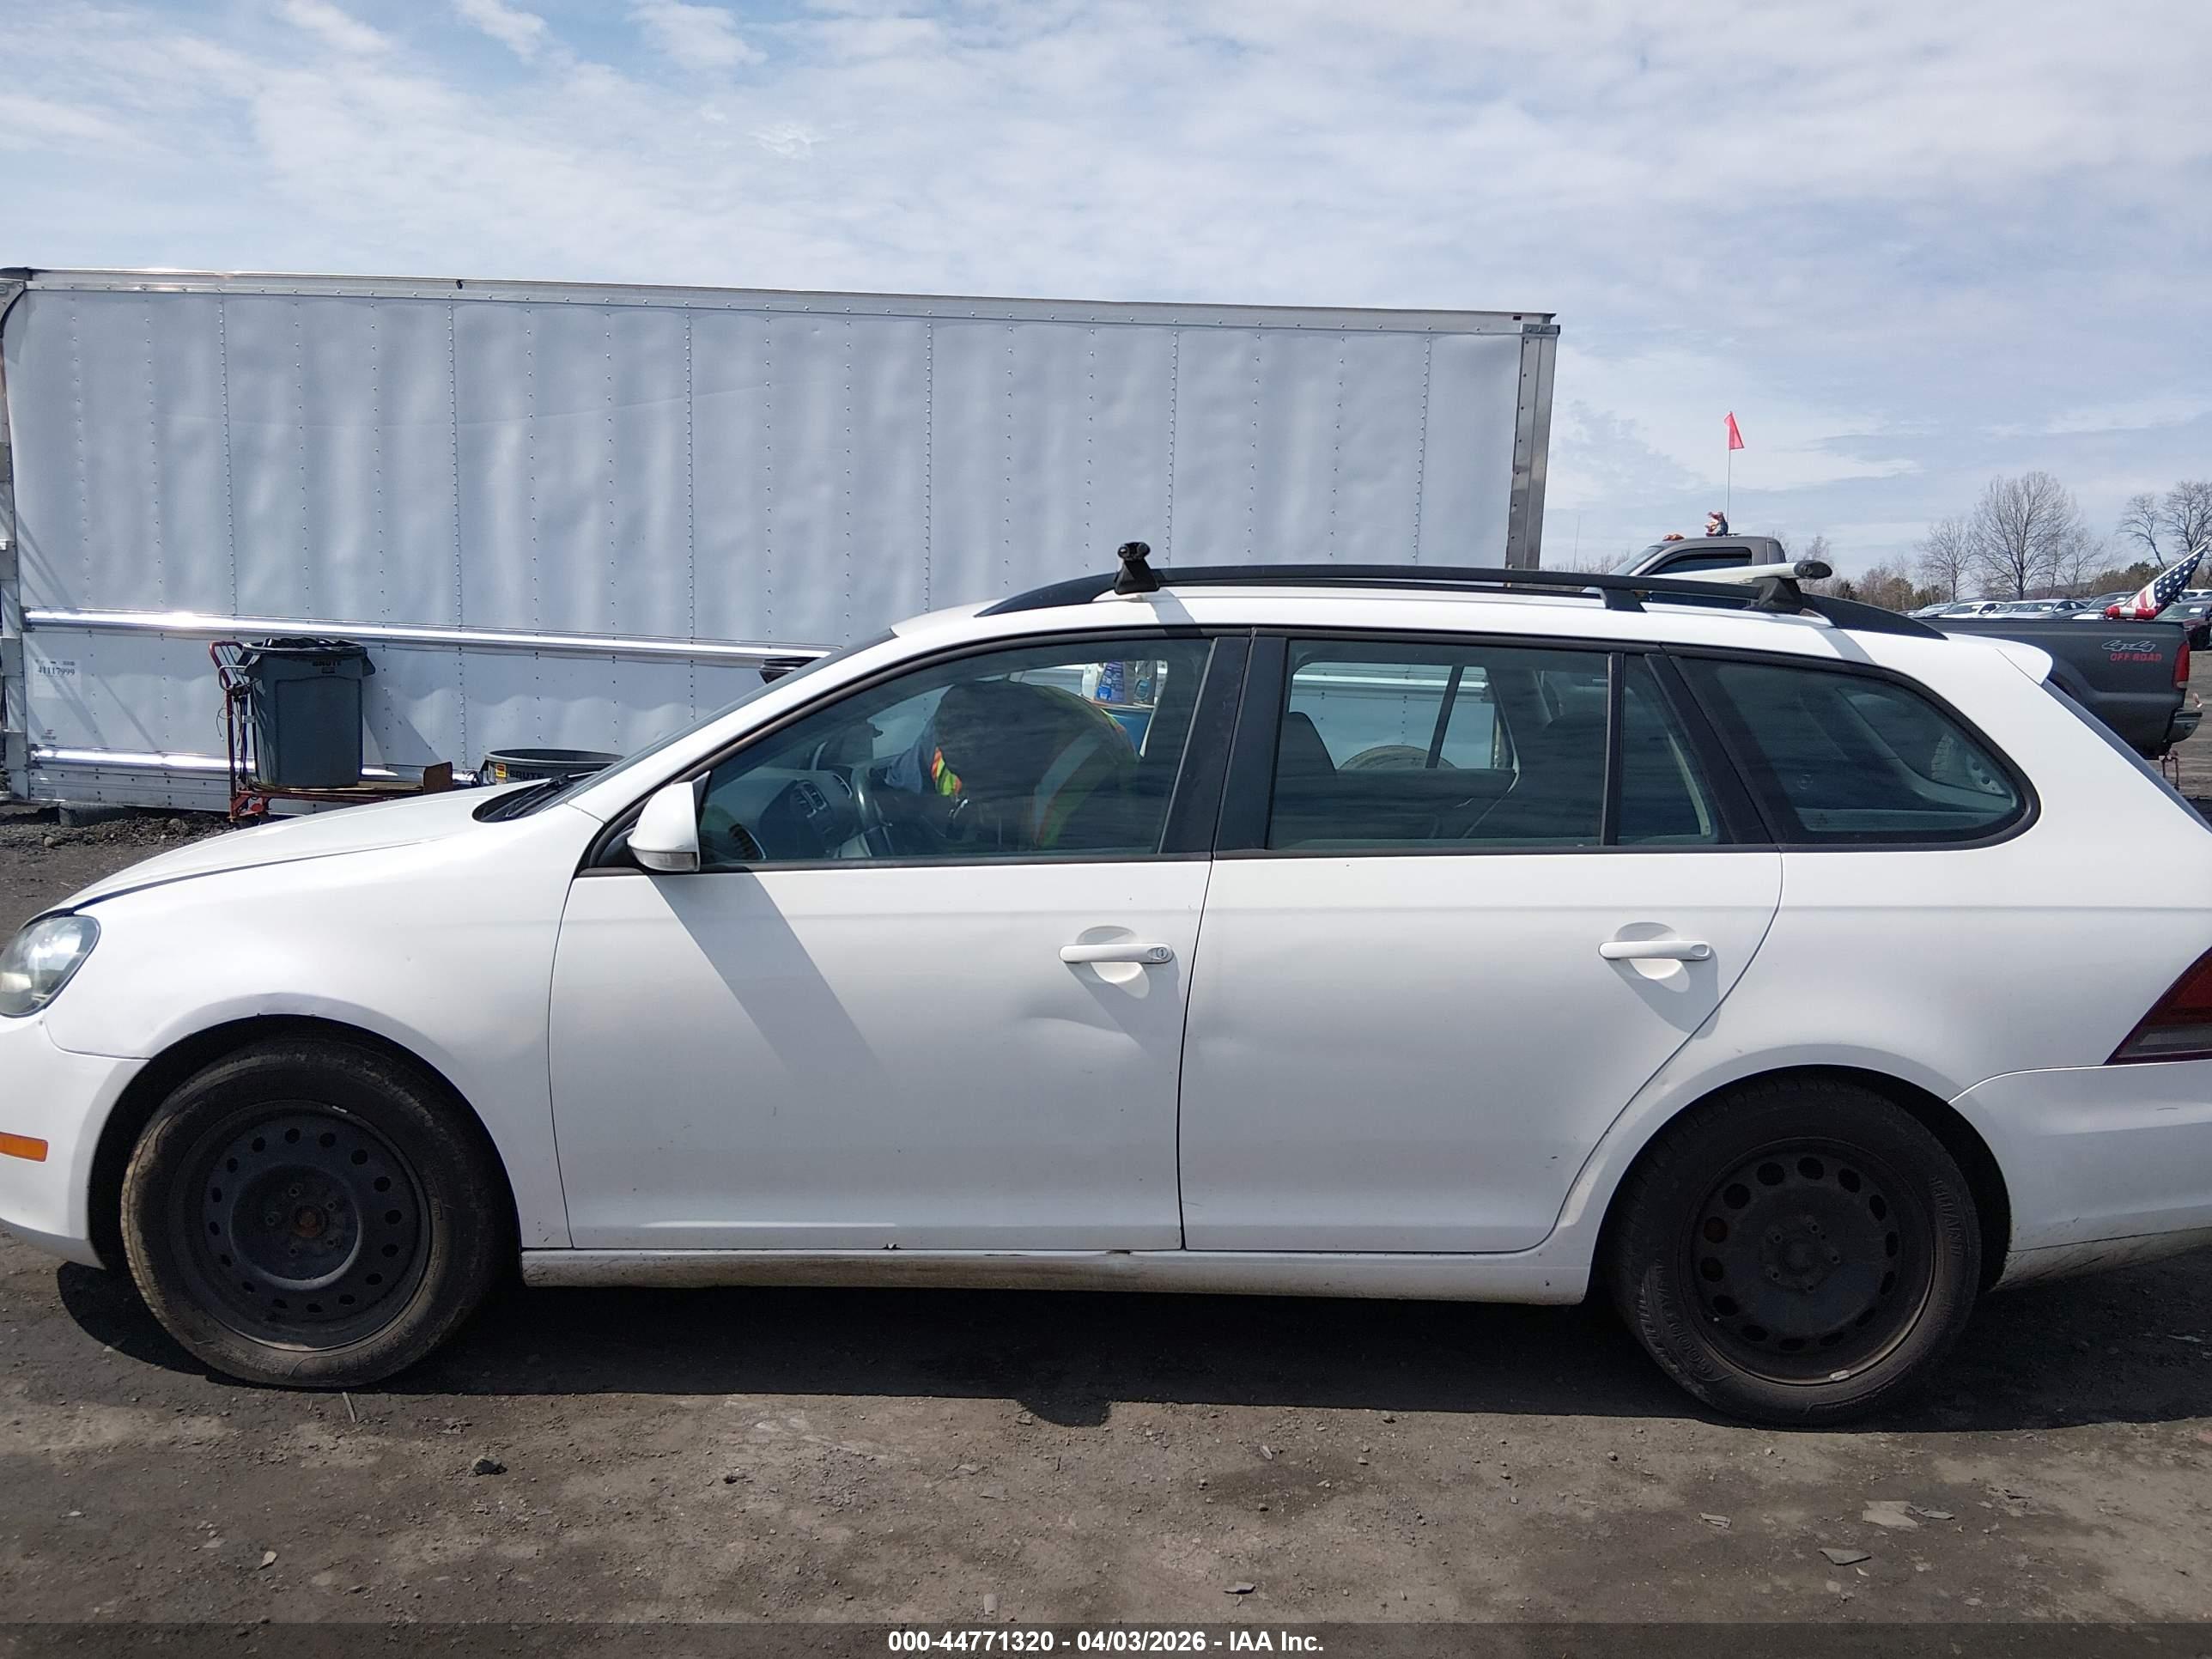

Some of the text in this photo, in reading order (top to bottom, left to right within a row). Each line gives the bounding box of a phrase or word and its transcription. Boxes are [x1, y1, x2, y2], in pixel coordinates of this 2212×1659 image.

[2101, 639, 2157, 653] 4x4
[2109, 652, 2163, 662] OFF ROAD
[509, 769, 544, 781] BRUTE
